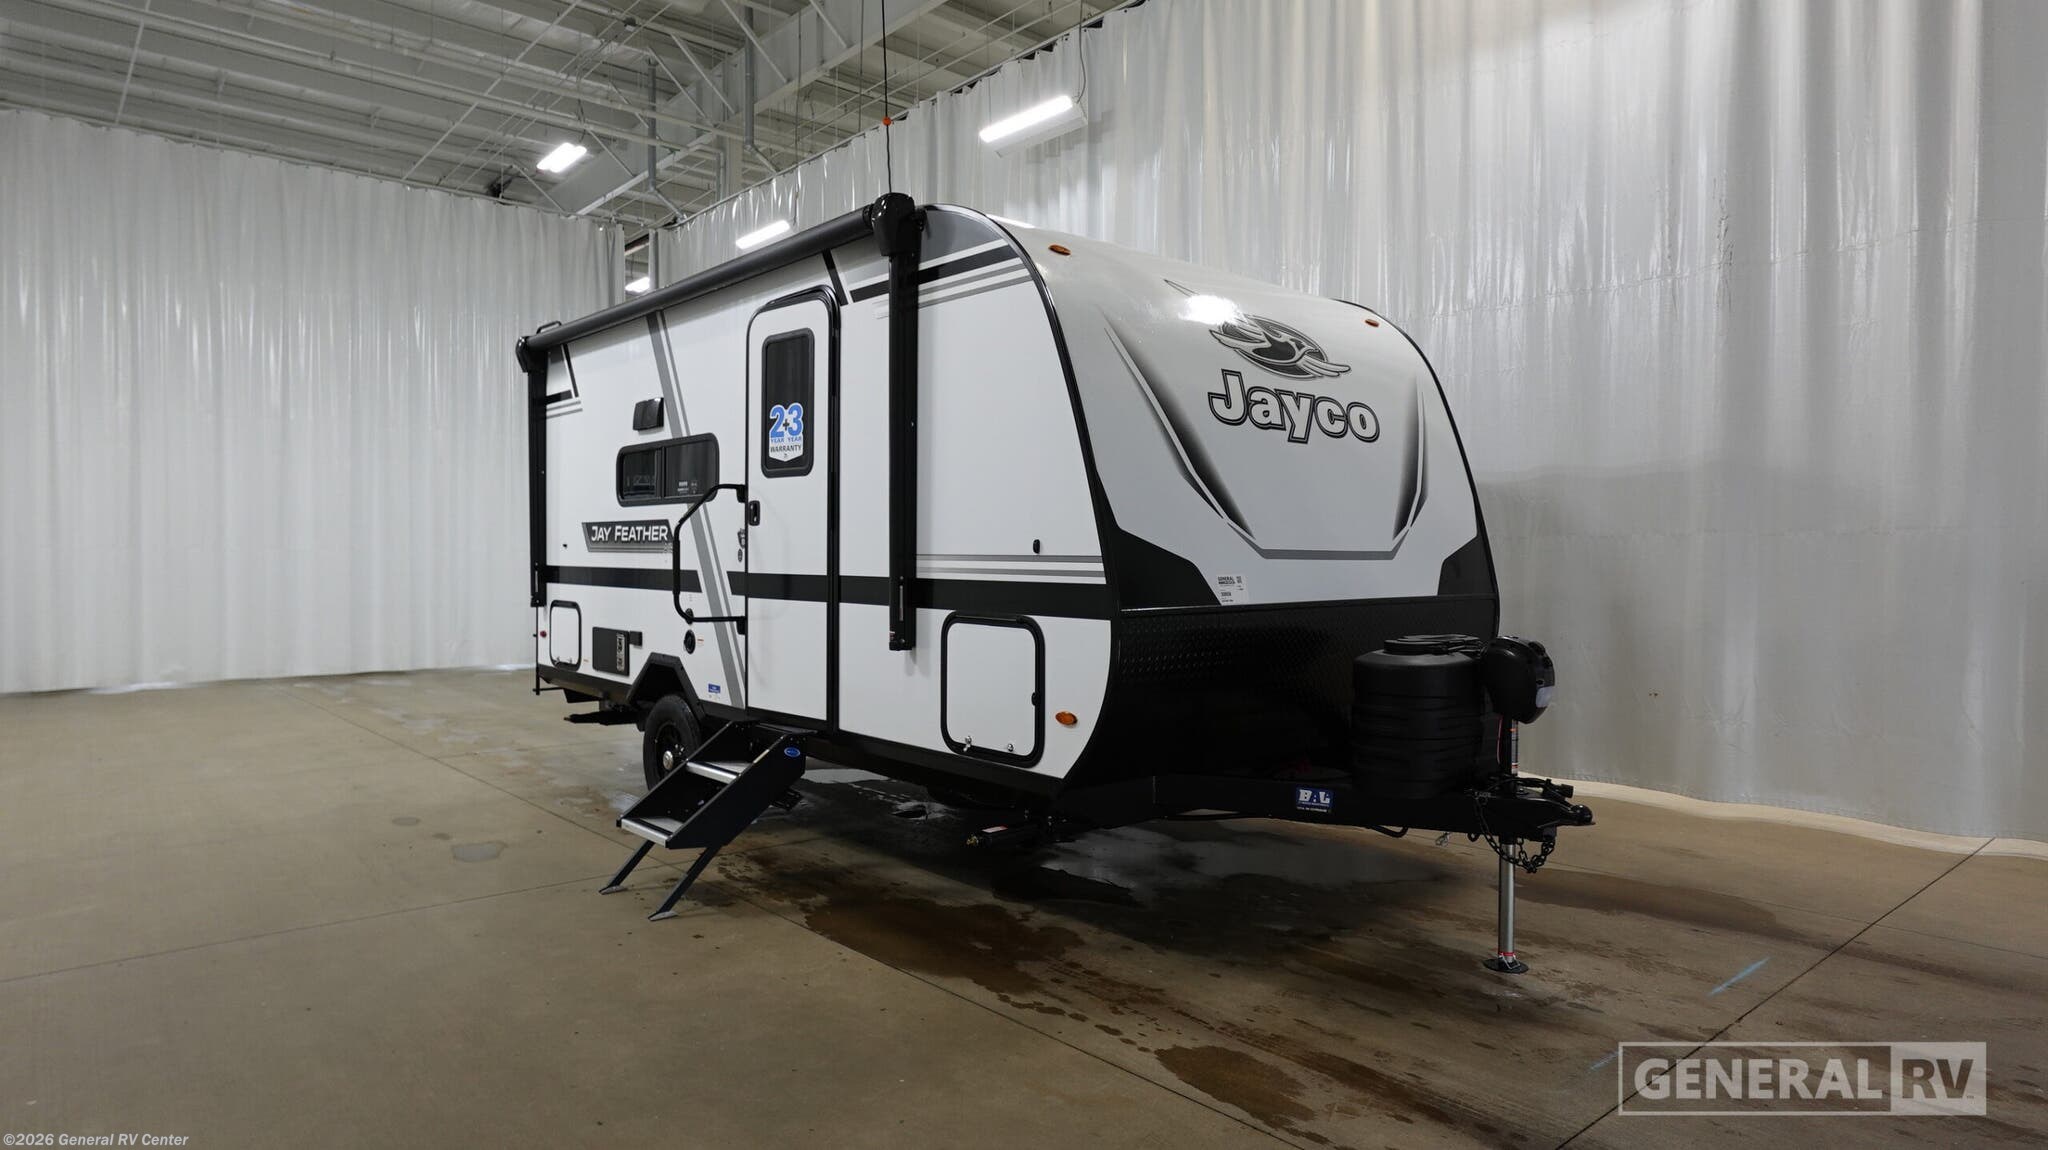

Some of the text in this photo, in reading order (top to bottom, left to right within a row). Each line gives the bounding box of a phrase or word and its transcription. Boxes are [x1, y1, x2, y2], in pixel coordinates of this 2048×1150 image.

[1208, 369, 1380, 444] Jayco
[770, 445, 802, 453] WARRANTY
[591, 525, 668, 541] JAY FEATHER
